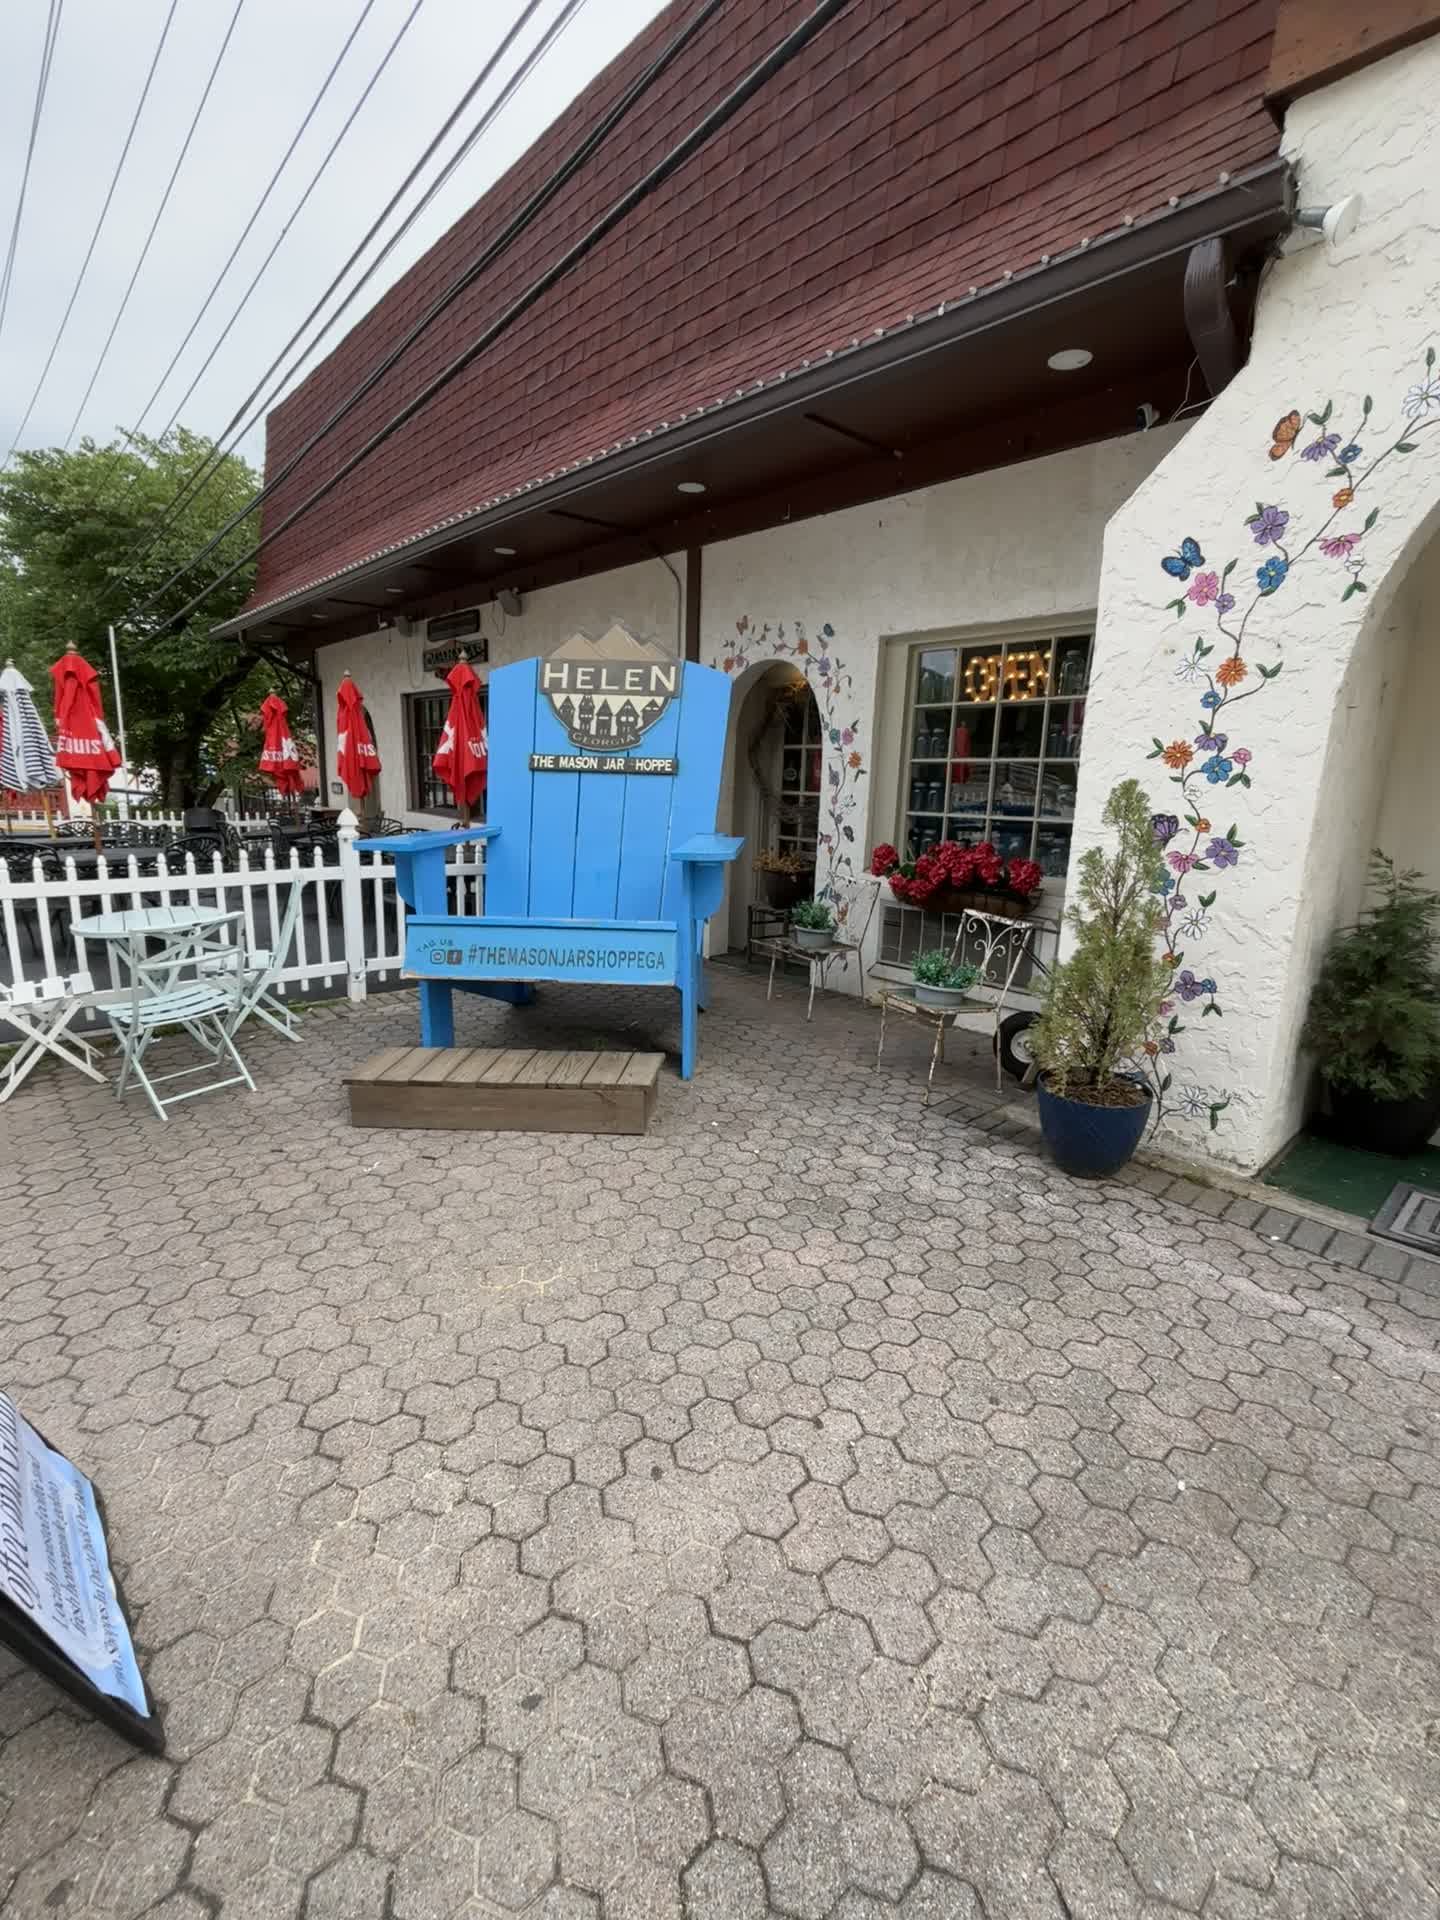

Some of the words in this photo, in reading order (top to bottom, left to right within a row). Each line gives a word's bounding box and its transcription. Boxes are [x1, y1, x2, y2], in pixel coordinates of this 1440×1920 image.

[543, 662, 677, 692] HELEN
[964, 651, 1055, 703] OPEN
[572, 733, 636, 746] GEORGIA
[532, 755, 555, 768] THE
[559, 756, 598, 769] MASON
[603, 758, 625, 770] JAR
[468, 944, 665, 970] #THEMASONJARSHOPPEGA
